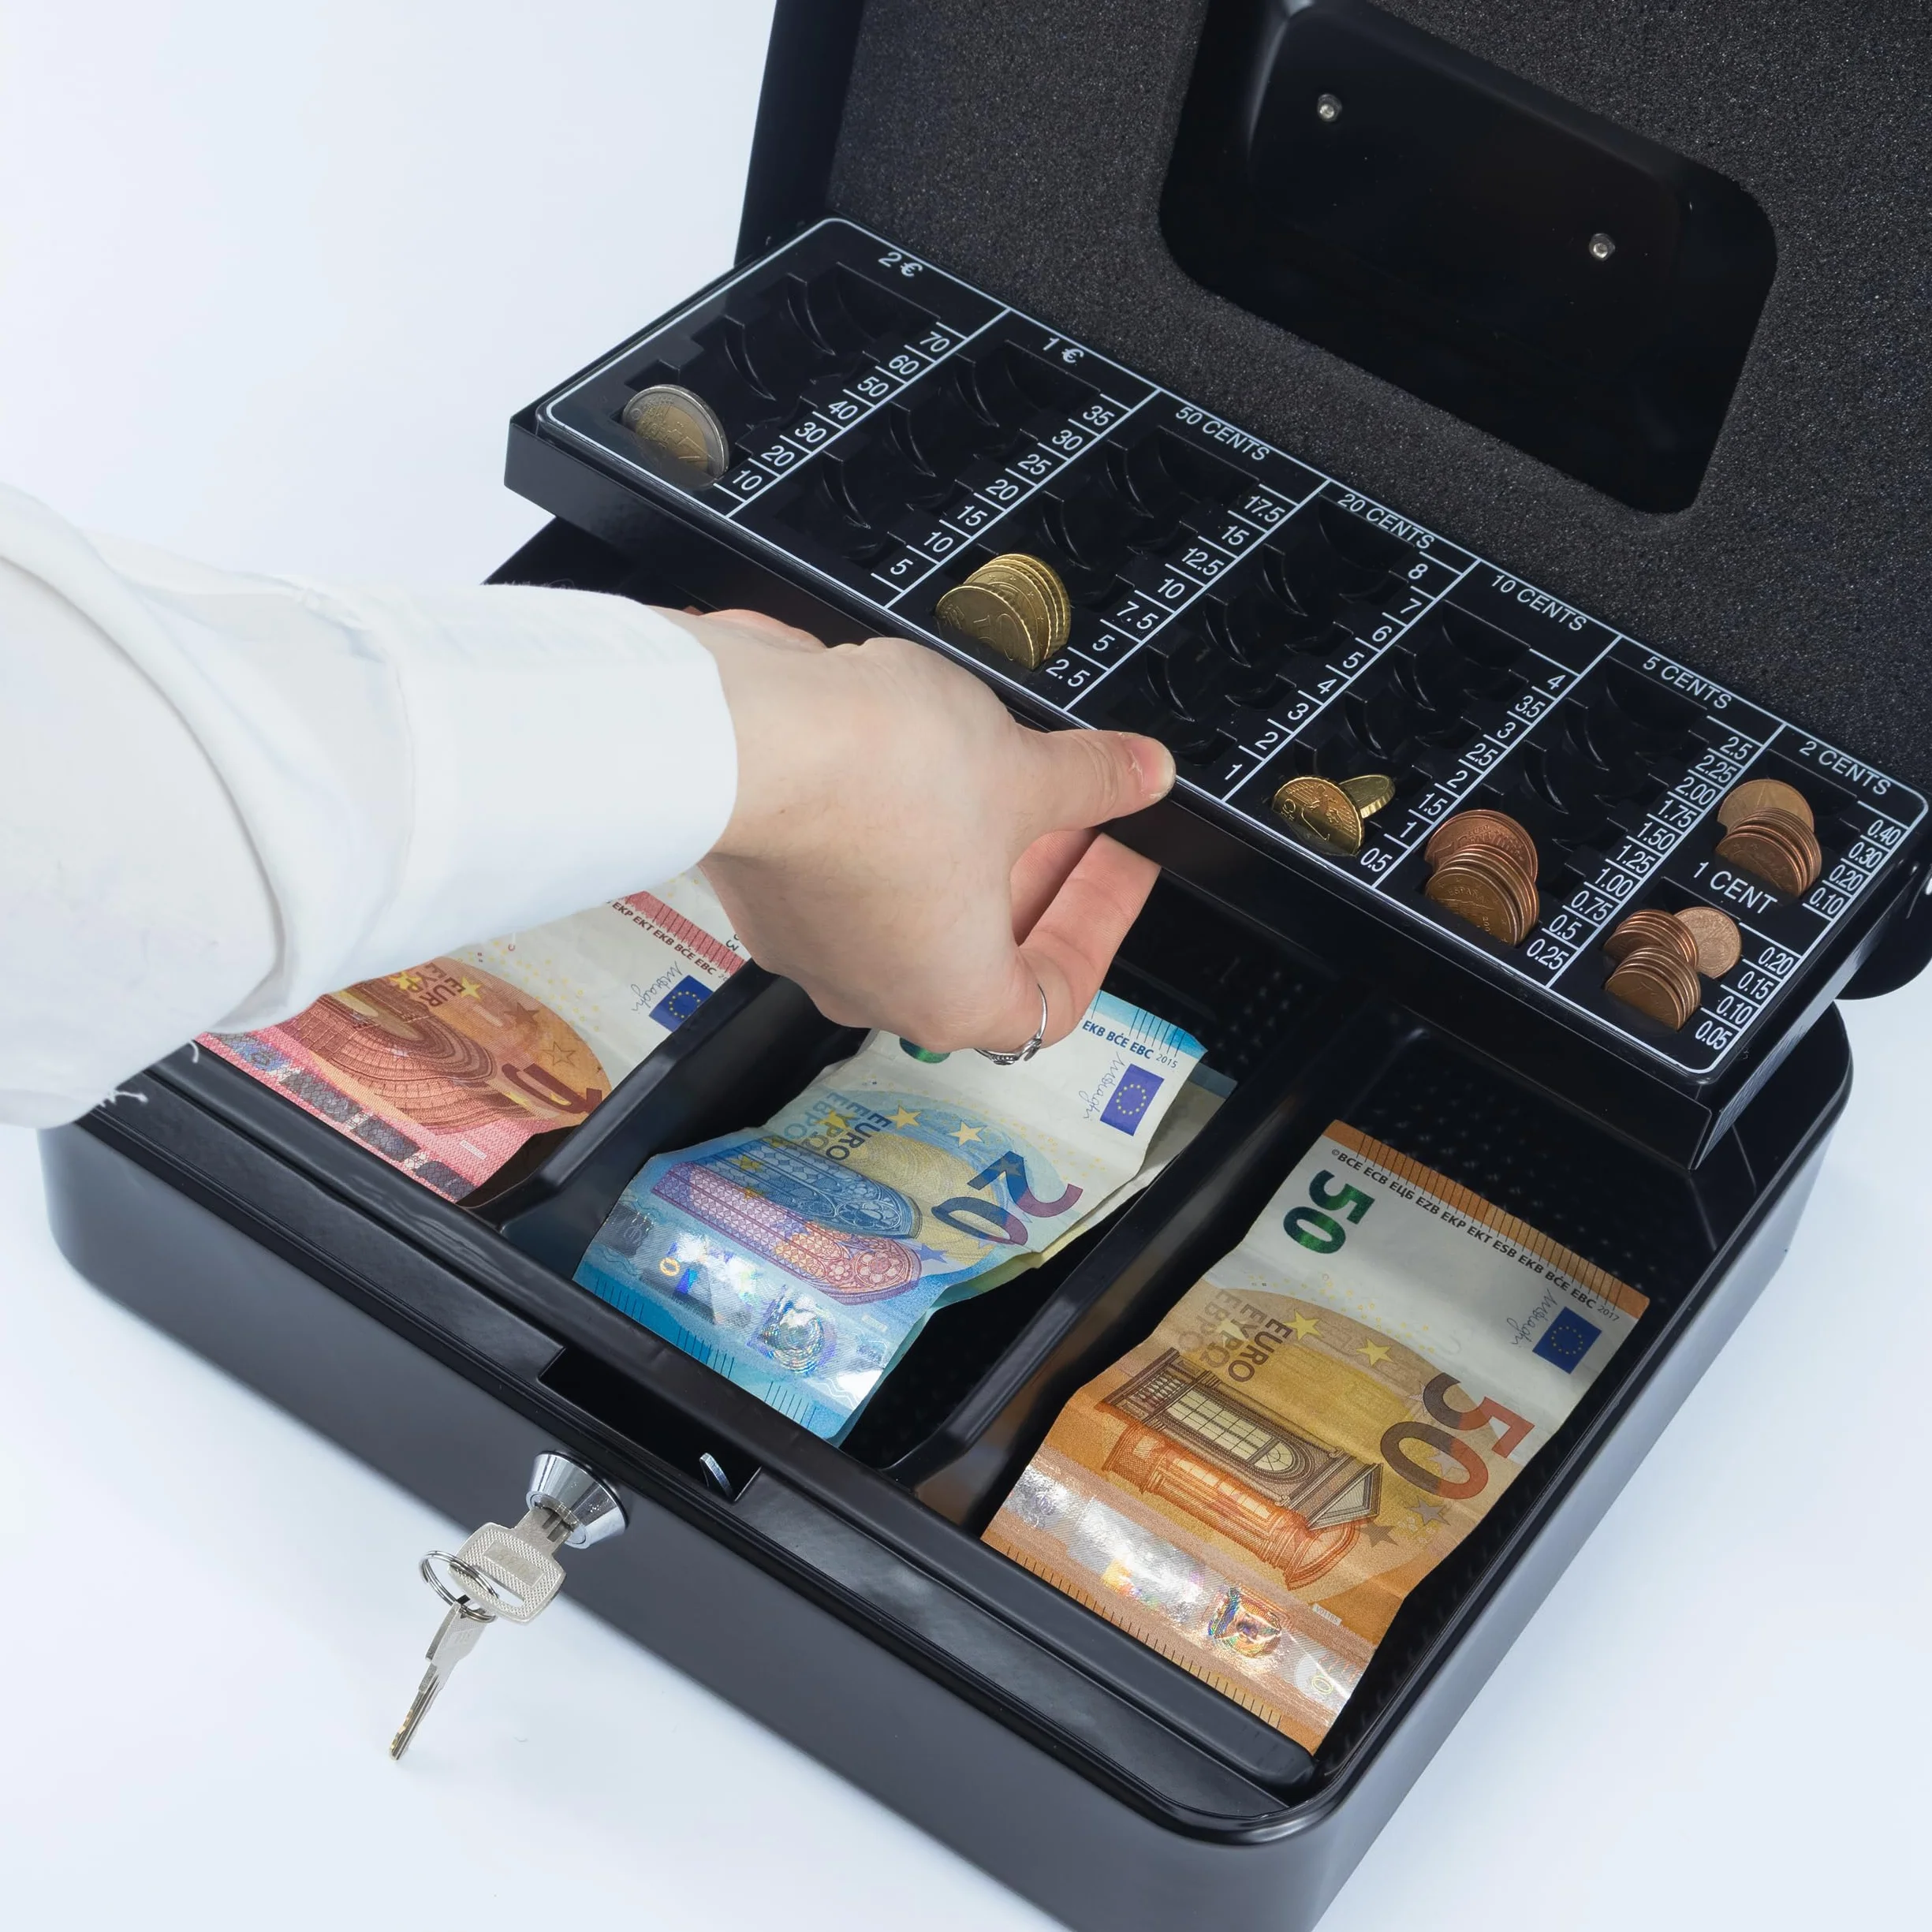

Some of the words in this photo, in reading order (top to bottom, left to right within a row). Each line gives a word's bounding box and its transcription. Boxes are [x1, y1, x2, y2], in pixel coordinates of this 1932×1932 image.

[878, 252, 902, 267] 2
[900, 263, 923, 277] €
[919, 330, 950, 352] 70
[1043, 338, 1060, 351] 1
[1061, 349, 1084, 364] €
[888, 355, 919, 375] 60
[857, 376, 890, 397] 50
[828, 401, 859, 420] 40
[1083, 405, 1115, 426] 35
[794, 421, 827, 443] 30
[1051, 429, 1083, 451] 30
[1175, 406, 1203, 425] 50
[1201, 419, 1270, 461] CENTS
[760, 445, 795, 467] 20
[1017, 453, 1052, 476] 25
[732, 470, 763, 490] 10
[985, 479, 1019, 501] 20
[957, 505, 988, 527] 15
[1244, 494, 1285, 523] 17.5
[1337, 493, 1366, 513] 20
[1366, 508, 1435, 549] CENTS
[923, 531, 953, 553] 10
[1221, 525, 1250, 546] 15
[890, 558, 914, 576] 5
[1181, 547, 1225, 576] 12.5
[1408, 563, 1428, 580] 8
[1157, 578, 1185, 599] 10
[1116, 600, 1159, 630] 7.5
[1400, 598, 1423, 614] 7
[1491, 575, 1516, 593] 10
[1516, 588, 1587, 631] CENTS
[1092, 634, 1116, 651] 5
[1372, 625, 1393, 642] 6
[1046, 658, 1091, 687] 2.5
[1342, 651, 1365, 669] 5
[1317, 678, 1337, 695] 4
[1547, 674, 1566, 690] 4
[1643, 655, 1661, 670] 5
[1661, 666, 1732, 709] CENTS
[1287, 703, 1309, 721] 3
[1515, 695, 1546, 718] 3.5
[1254, 731, 1279, 751] 2
[1497, 722, 1516, 739] 3
[1465, 743, 1499, 766] 2.5
[1719, 736, 1753, 760] 2.5
[1225, 763, 1243, 781] 1
[1446, 770, 1468, 789] 2
[1695, 755, 1737, 783] 2.25
[1799, 740, 1817, 756] 2
[1818, 750, 1891, 795] CENTS
[1674, 776, 1716, 805] 2.00
[1418, 793, 1449, 816] 1.5
[1658, 799, 1698, 828] 1.75
[1400, 821, 1417, 838] 1
[1637, 822, 1676, 851] 1.50
[1866, 817, 1902, 848] 0.40
[1360, 848, 1393, 872] 0.5
[1616, 844, 1656, 874] 1.25
[1847, 839, 1884, 871] 0.30
[1594, 867, 1634, 897] 1.00
[1693, 861, 1710, 878] 1
[1710, 871, 1778, 914] CENT
[1827, 862, 1864, 893] 0.20
[1571, 890, 1613, 921] 0.75
[1808, 886, 1845, 918] 0.10
[612, 901, 633, 916] EKP
[653, 929, 674, 945] EKB
[694, 958, 717, 975] EBC
[1549, 912, 1579, 941] 0.5
[1526, 938, 1570, 970] 0.25
[1758, 946, 1794, 975] 0.20
[1737, 971, 1774, 1000] 0.15
[1716, 995, 1753, 1025] 0.10
[1082, 1020, 1106, 1037] EKB
[1129, 1042, 1154, 1060] EBC
[1156, 1053, 1179, 1069] 2015
[1695, 1020, 1733, 1050] 0.05
[825, 1112, 893, 1162] EURO
[931, 1151, 1083, 1246] 20
[1283, 1169, 1375, 1254] 50
[1363, 1166, 1389, 1185] ECB
[1415, 1195, 1441, 1215] EZB
[1441, 1210, 1467, 1229] EKP
[1466, 1225, 1493, 1244] EKT
[1492, 1240, 1518, 1258] ESB
[1518, 1255, 1544, 1274] EKB
[1570, 1288, 1597, 1309] EBC
[1597, 1305, 1621, 1322] 2017
[1228, 1318, 1294, 1382] EURO
[1380, 1371, 1536, 1500] 50
